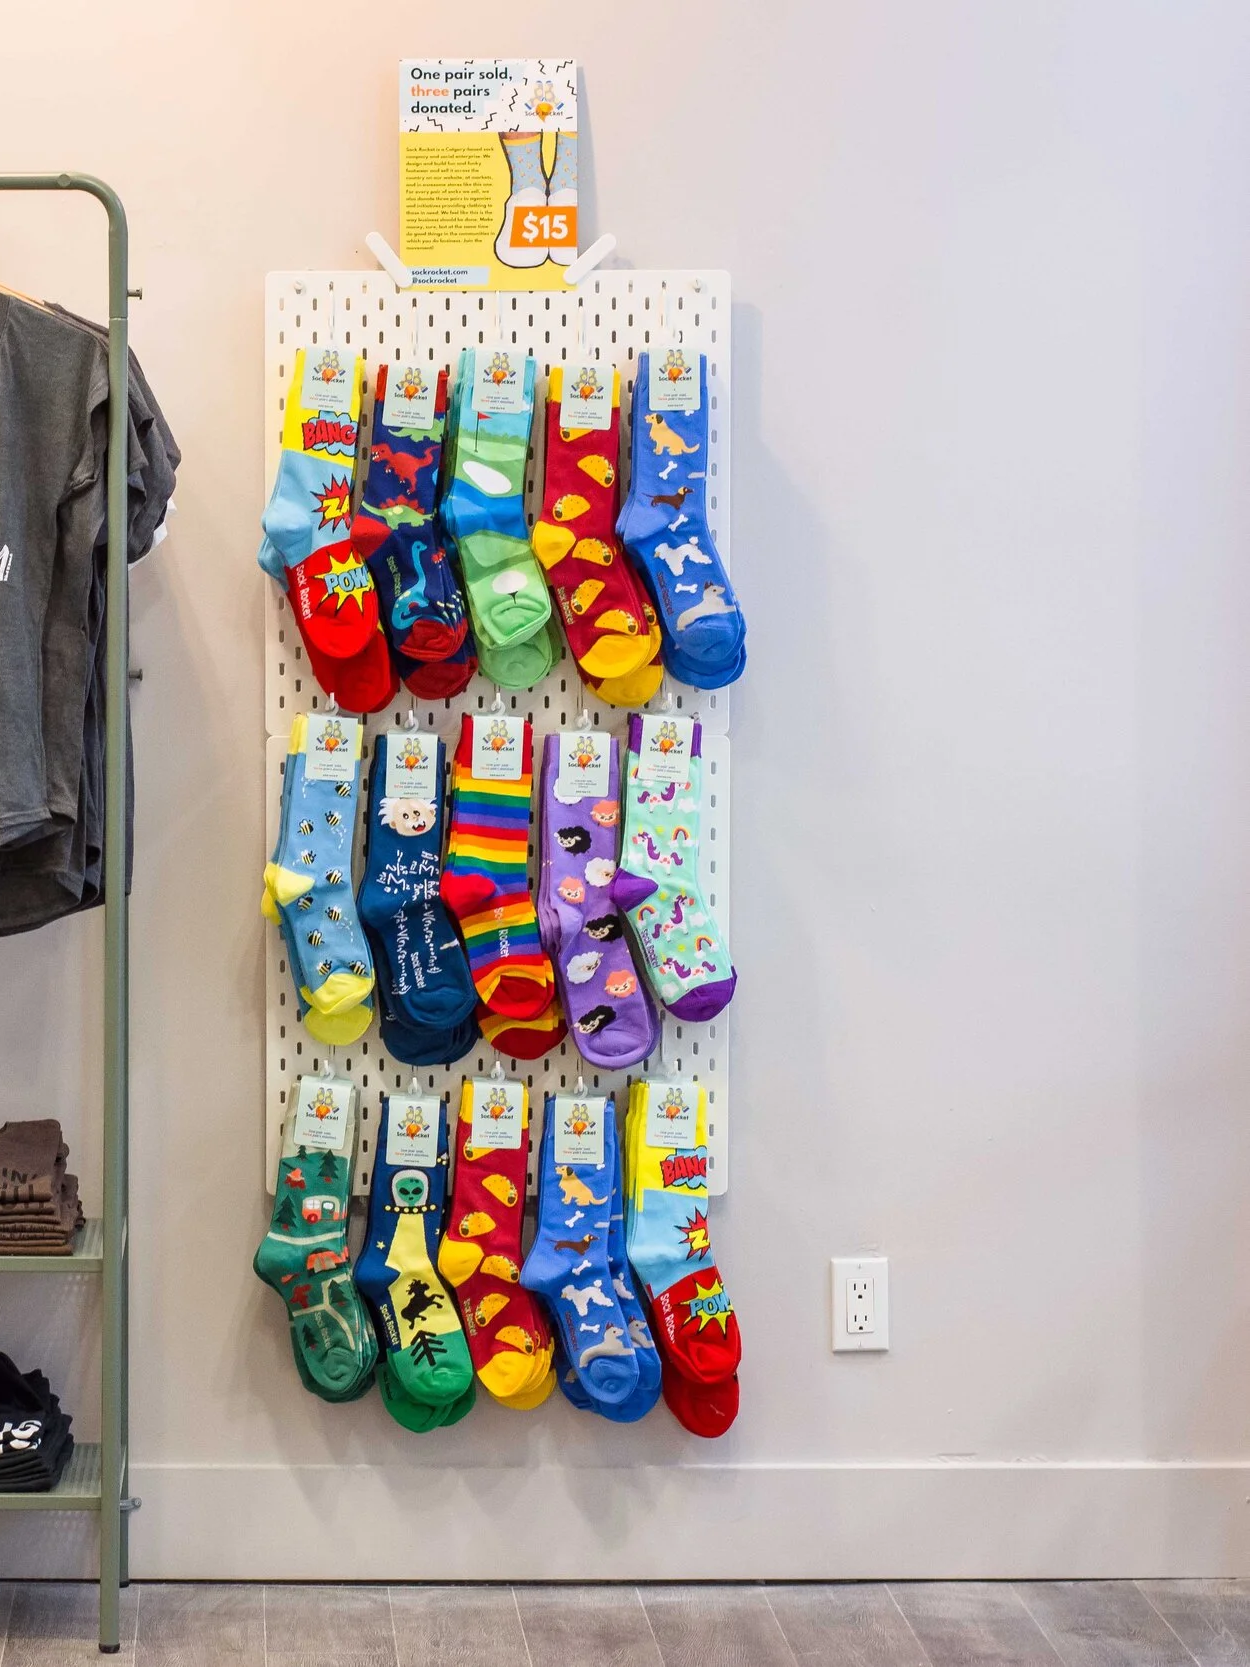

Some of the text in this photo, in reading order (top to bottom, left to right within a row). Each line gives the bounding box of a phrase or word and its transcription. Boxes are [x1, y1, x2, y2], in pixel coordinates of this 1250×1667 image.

[410, 67, 513, 83] One pair sold,
[410, 84, 490, 100] three pairs
[410, 101, 477, 114] donated.
[522, 211, 568, 243] $15
[411, 268, 468, 276] sockrocket.com
[412, 276, 457, 284] @sockrocket
[302, 418, 358, 451] BANG
[296, 564, 313, 620] Sock Rocket
[324, 565, 370, 595] POW
[499, 929, 510, 958] Rocket
[660, 1293, 672, 1314] Sock
[380, 1303, 400, 1346] Sock Rocket
